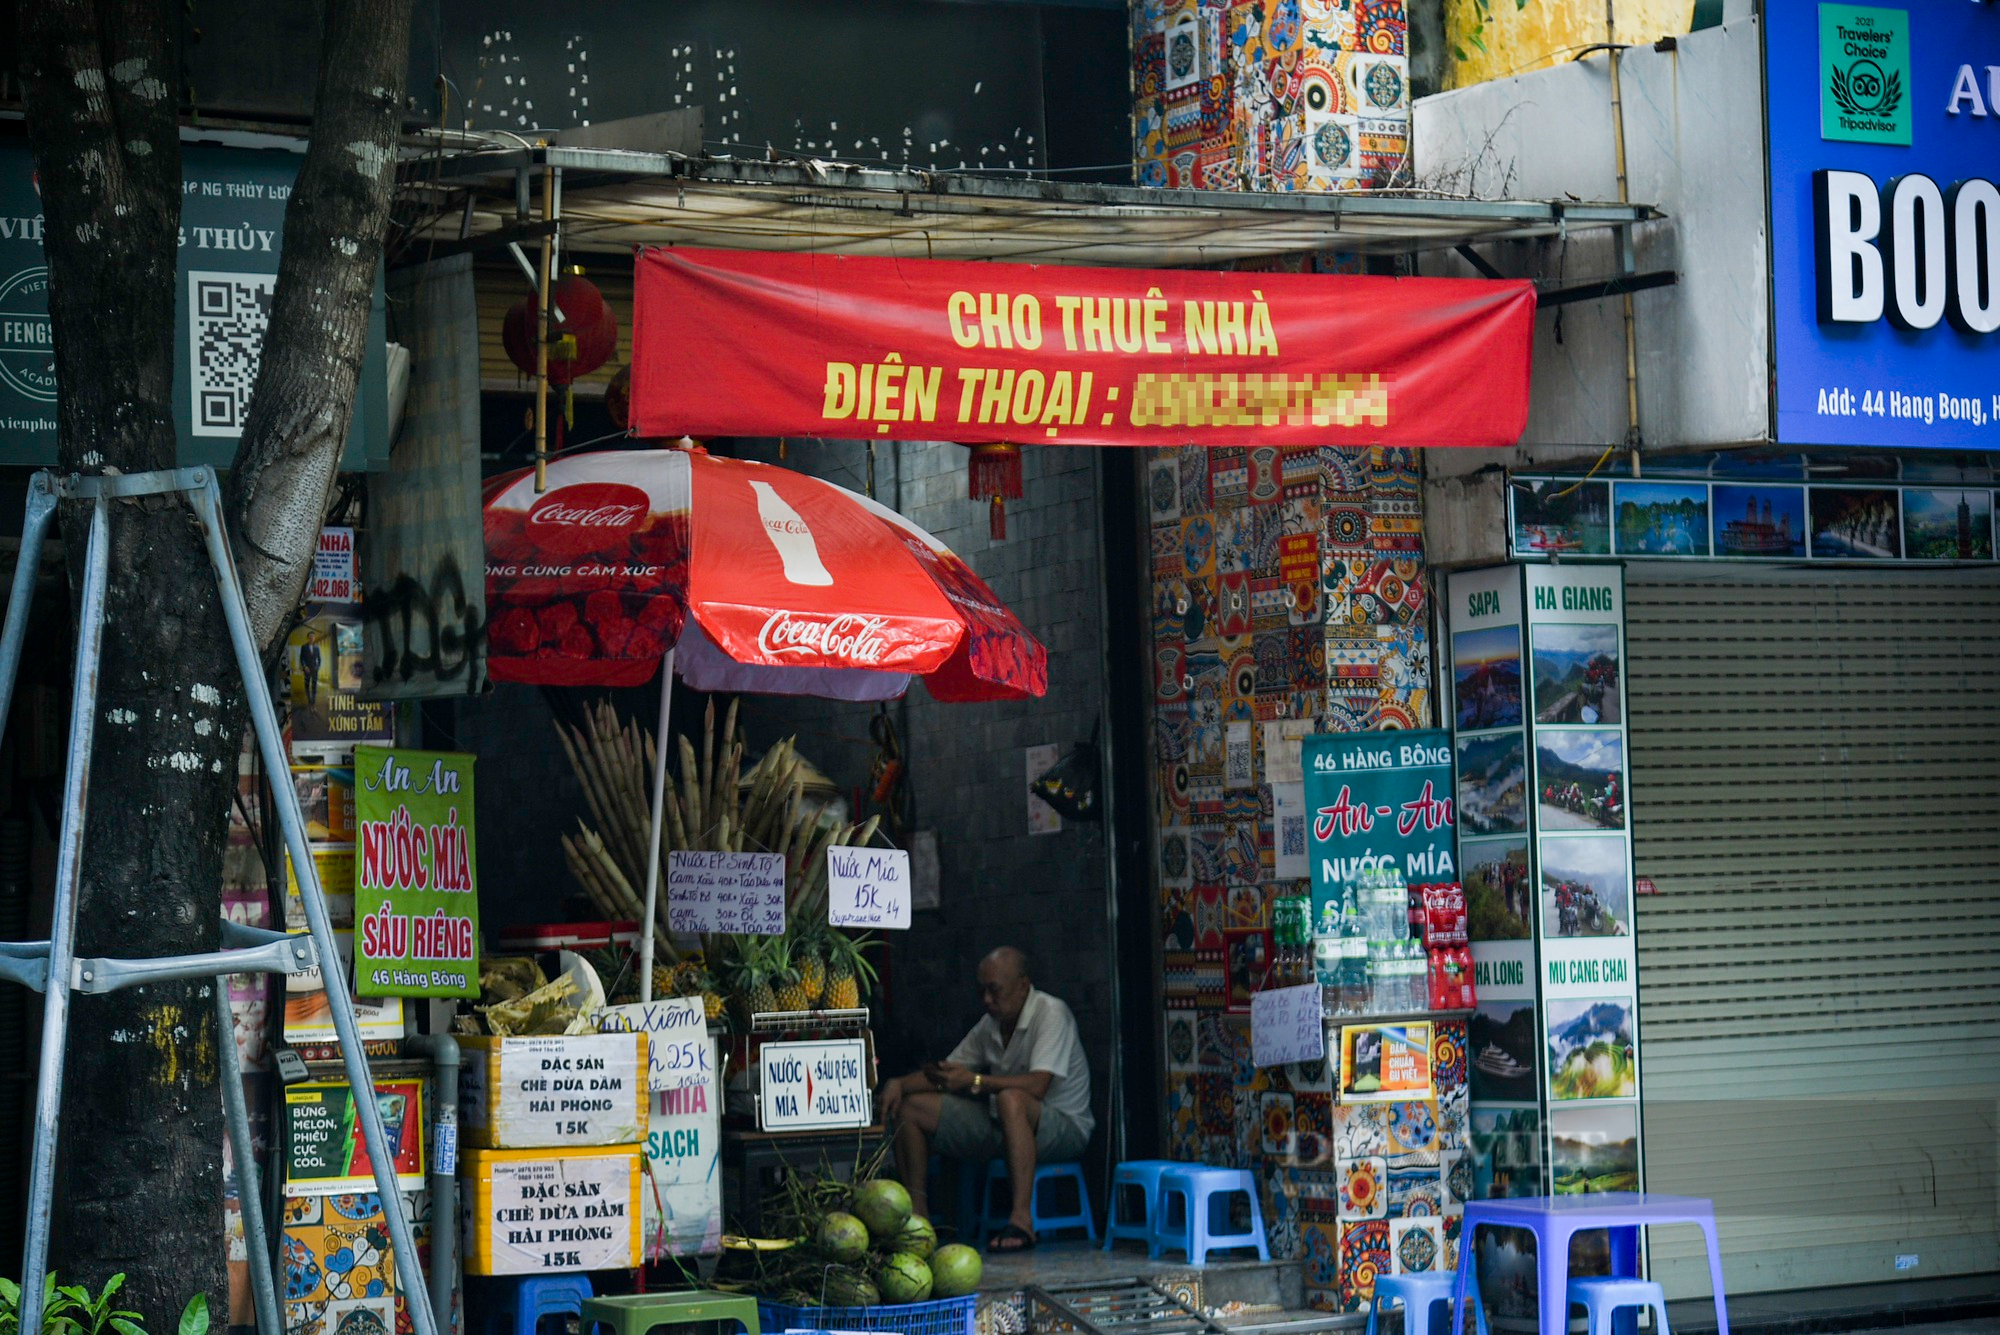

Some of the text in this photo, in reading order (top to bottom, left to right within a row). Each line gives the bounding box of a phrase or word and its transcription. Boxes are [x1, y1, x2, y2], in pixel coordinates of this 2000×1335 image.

[1854, 16, 1874, 27] 2021
[1843, 41, 1888, 60] Choice
[1837, 116, 1896, 133] Tripadvisor
[192, 221, 276, 252] THỦY
[947, 286, 1280, 357] CHO THUÊ NHÀ
[822, 351, 944, 434] ĐIỆN
[956, 365, 1095, 437] THOẠI
[1817, 387, 1857, 417] Add:
[1862, 389, 1886, 418] 44
[1890, 390, 1934, 426] Hang
[1938, 392, 1988, 427] Bong,
[531, 502, 646, 526] Coca-Cola
[521, 563, 572, 577] CÙNG
[576, 563, 616, 577] CẢM
[1468, 589, 1500, 618] SAPA
[1534, 585, 1613, 612] HA GIANG
[758, 609, 890, 662] Coca-Cola
[1313, 742, 1452, 771] 46 HÀNG BÔNG
[364, 756, 461, 795] An An
[361, 804, 428, 890] NƯỚC
[431, 806, 473, 892] MÍA
[1406, 842, 1455, 877] MÍA
[669, 870, 695, 884] Cam
[361, 900, 473, 961] SẦU RIÊNG
[372, 967, 466, 990] 46 Hàng Bông
[1475, 959, 1524, 986] HA LONG
[1549, 957, 1628, 984] MU CANG CHAI
[541, 1054, 605, 1073] ĐẶC SẢN
[768, 1052, 803, 1084] NƯỚC
[520, 1076, 547, 1092] CHÈ
[553, 1075, 584, 1091] DỪA
[293, 1105, 327, 1118] BỪNG
[529, 1096, 613, 1113] HẢI PHÒNG
[775, 1086, 799, 1118] MÍA
[293, 1119, 338, 1131] MELON,
[647, 1128, 700, 1166] SẠCH
[293, 1157, 326, 1168] COOL
[521, 1180, 602, 1203] ĐẶC SẢN
[496, 1204, 534, 1223] CHÈ
[539, 1203, 579, 1220] DỪA
[548, 1224, 613, 1243] PHÒNG
[542, 1250, 582, 1267] 15K
